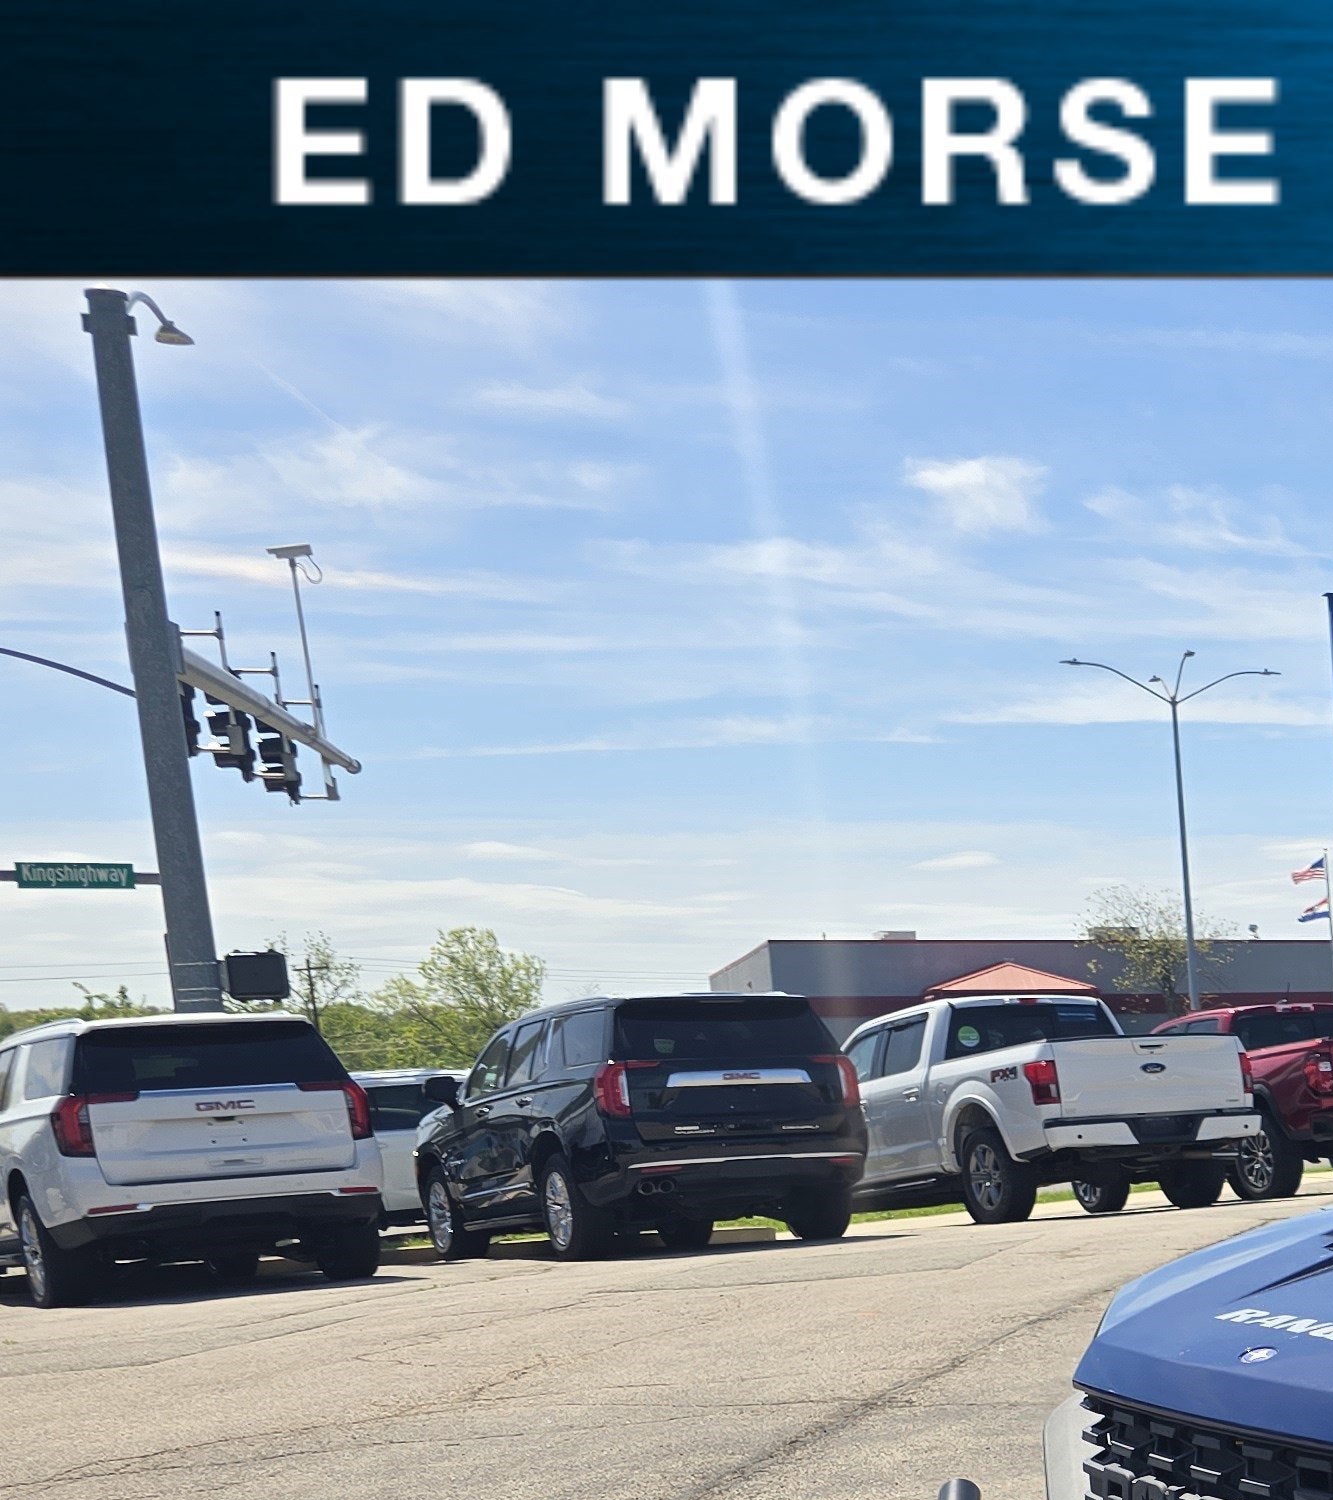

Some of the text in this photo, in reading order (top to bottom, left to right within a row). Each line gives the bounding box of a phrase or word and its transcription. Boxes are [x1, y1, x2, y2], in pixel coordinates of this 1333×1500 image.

[21, 864, 128, 887] Kingshighway
[723, 1072, 761, 1081] GMC
[991, 1066, 1018, 1083] FX4
[195, 1099, 256, 1112] GMC
